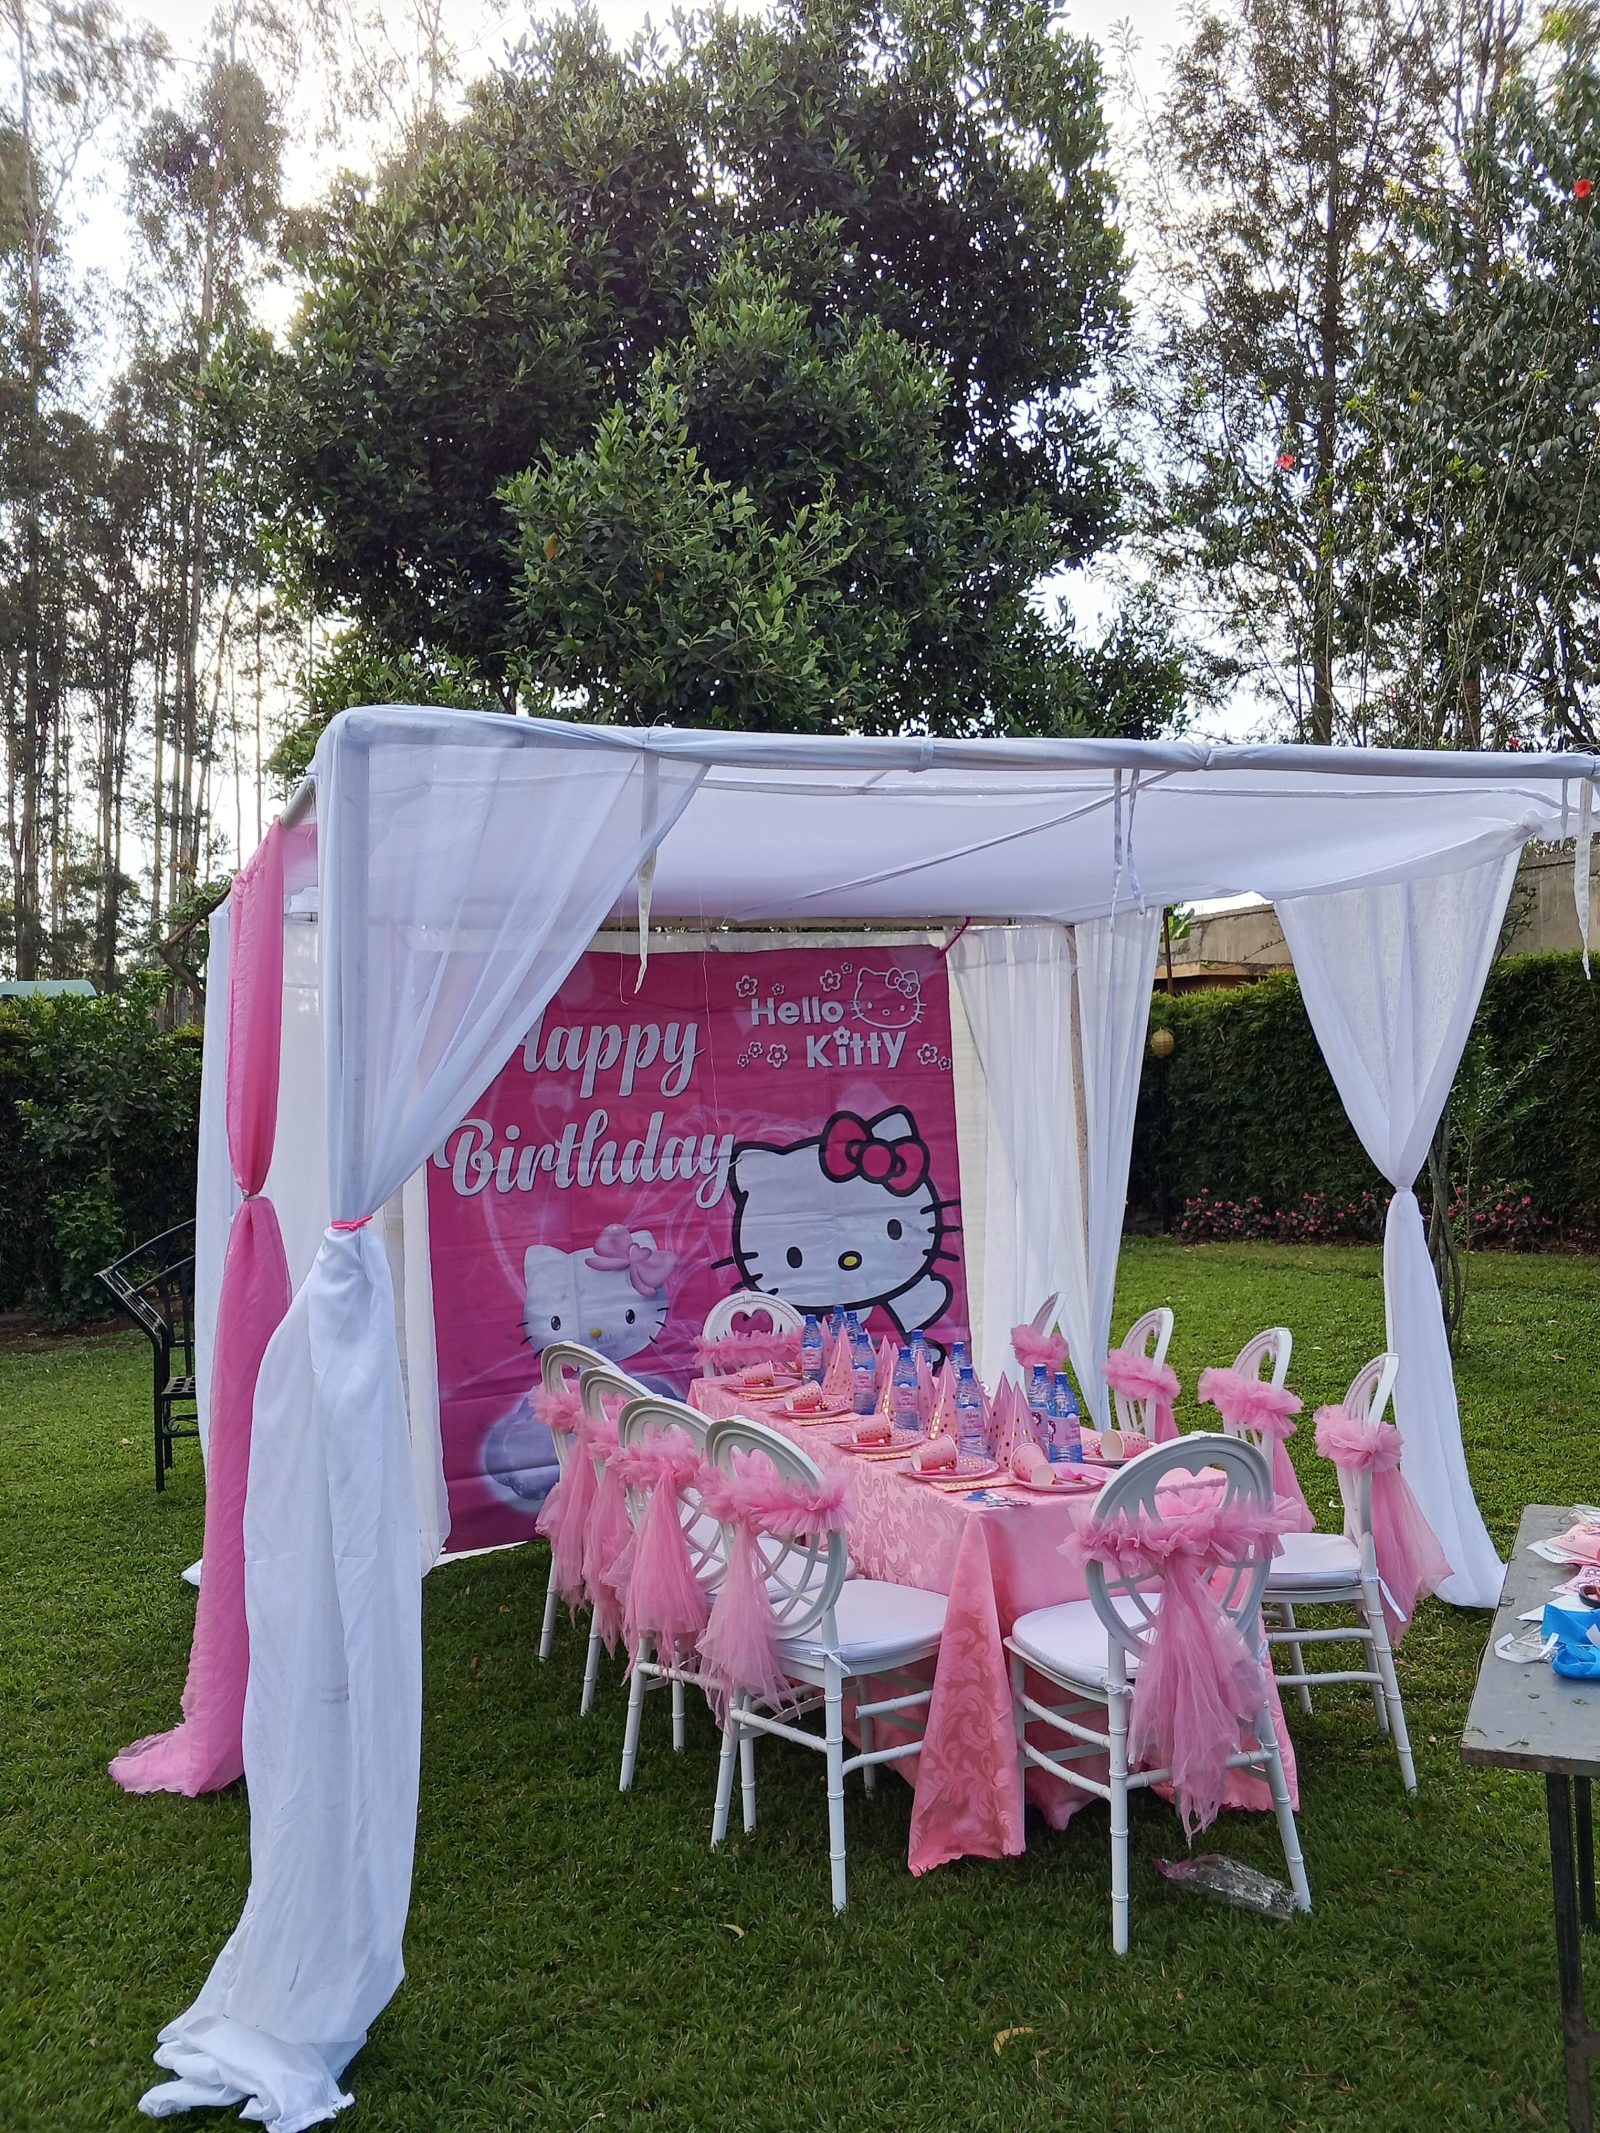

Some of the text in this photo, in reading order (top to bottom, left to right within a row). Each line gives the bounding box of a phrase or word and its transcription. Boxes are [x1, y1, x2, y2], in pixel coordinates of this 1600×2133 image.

[751, 996, 844, 1026] Hello
[806, 1026, 907, 1069] Kitty
[434, 1109, 743, 1209] Birthday
